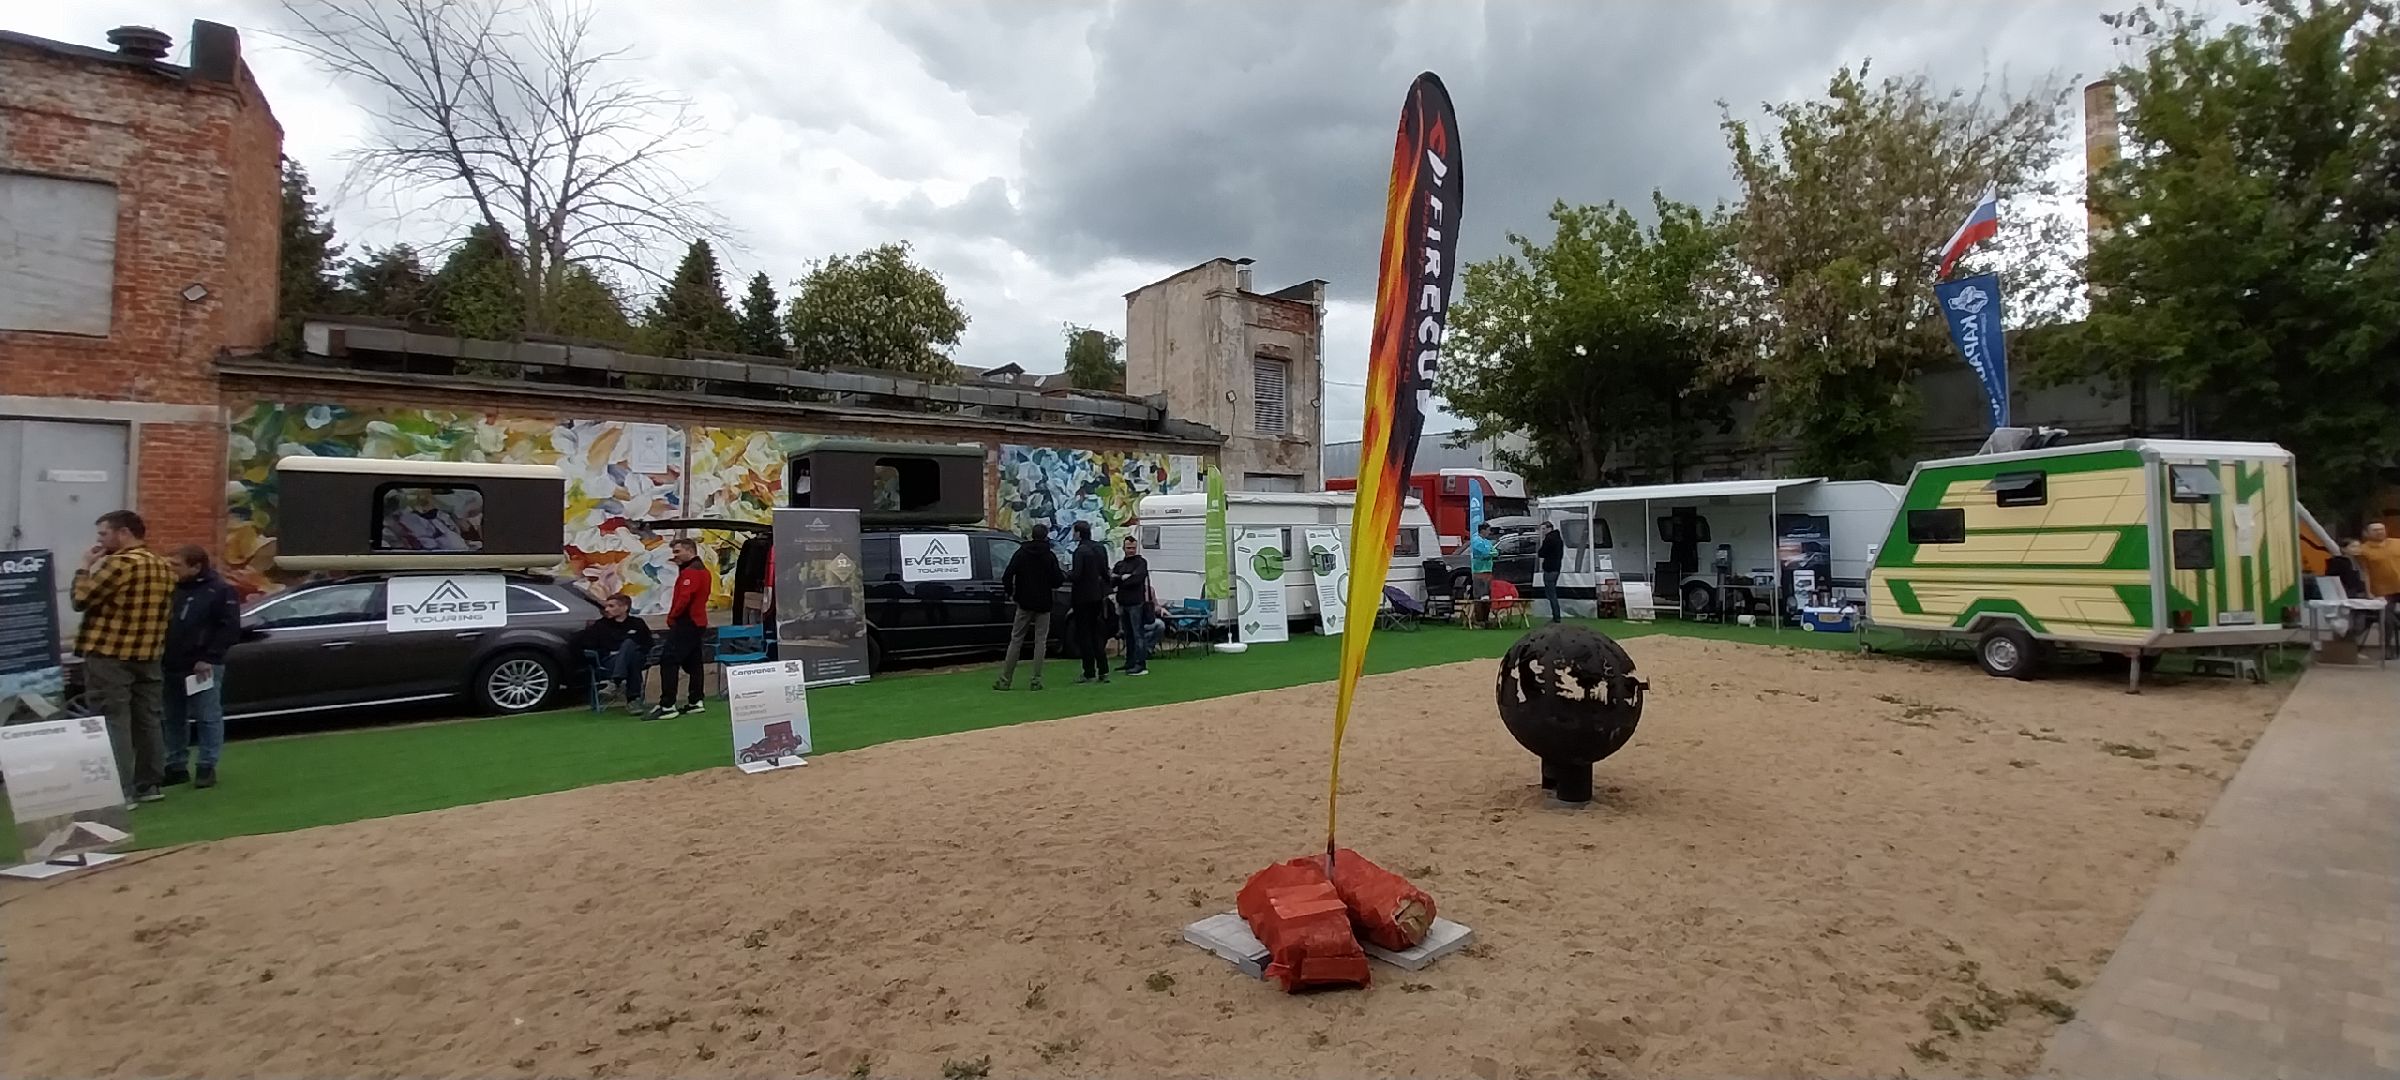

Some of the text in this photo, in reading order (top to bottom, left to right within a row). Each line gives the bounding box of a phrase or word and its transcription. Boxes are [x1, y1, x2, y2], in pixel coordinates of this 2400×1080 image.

[904, 555, 968, 567] EVEREST
[391, 600, 501, 616] EVEREST
[412, 614, 483, 624] TOURING
